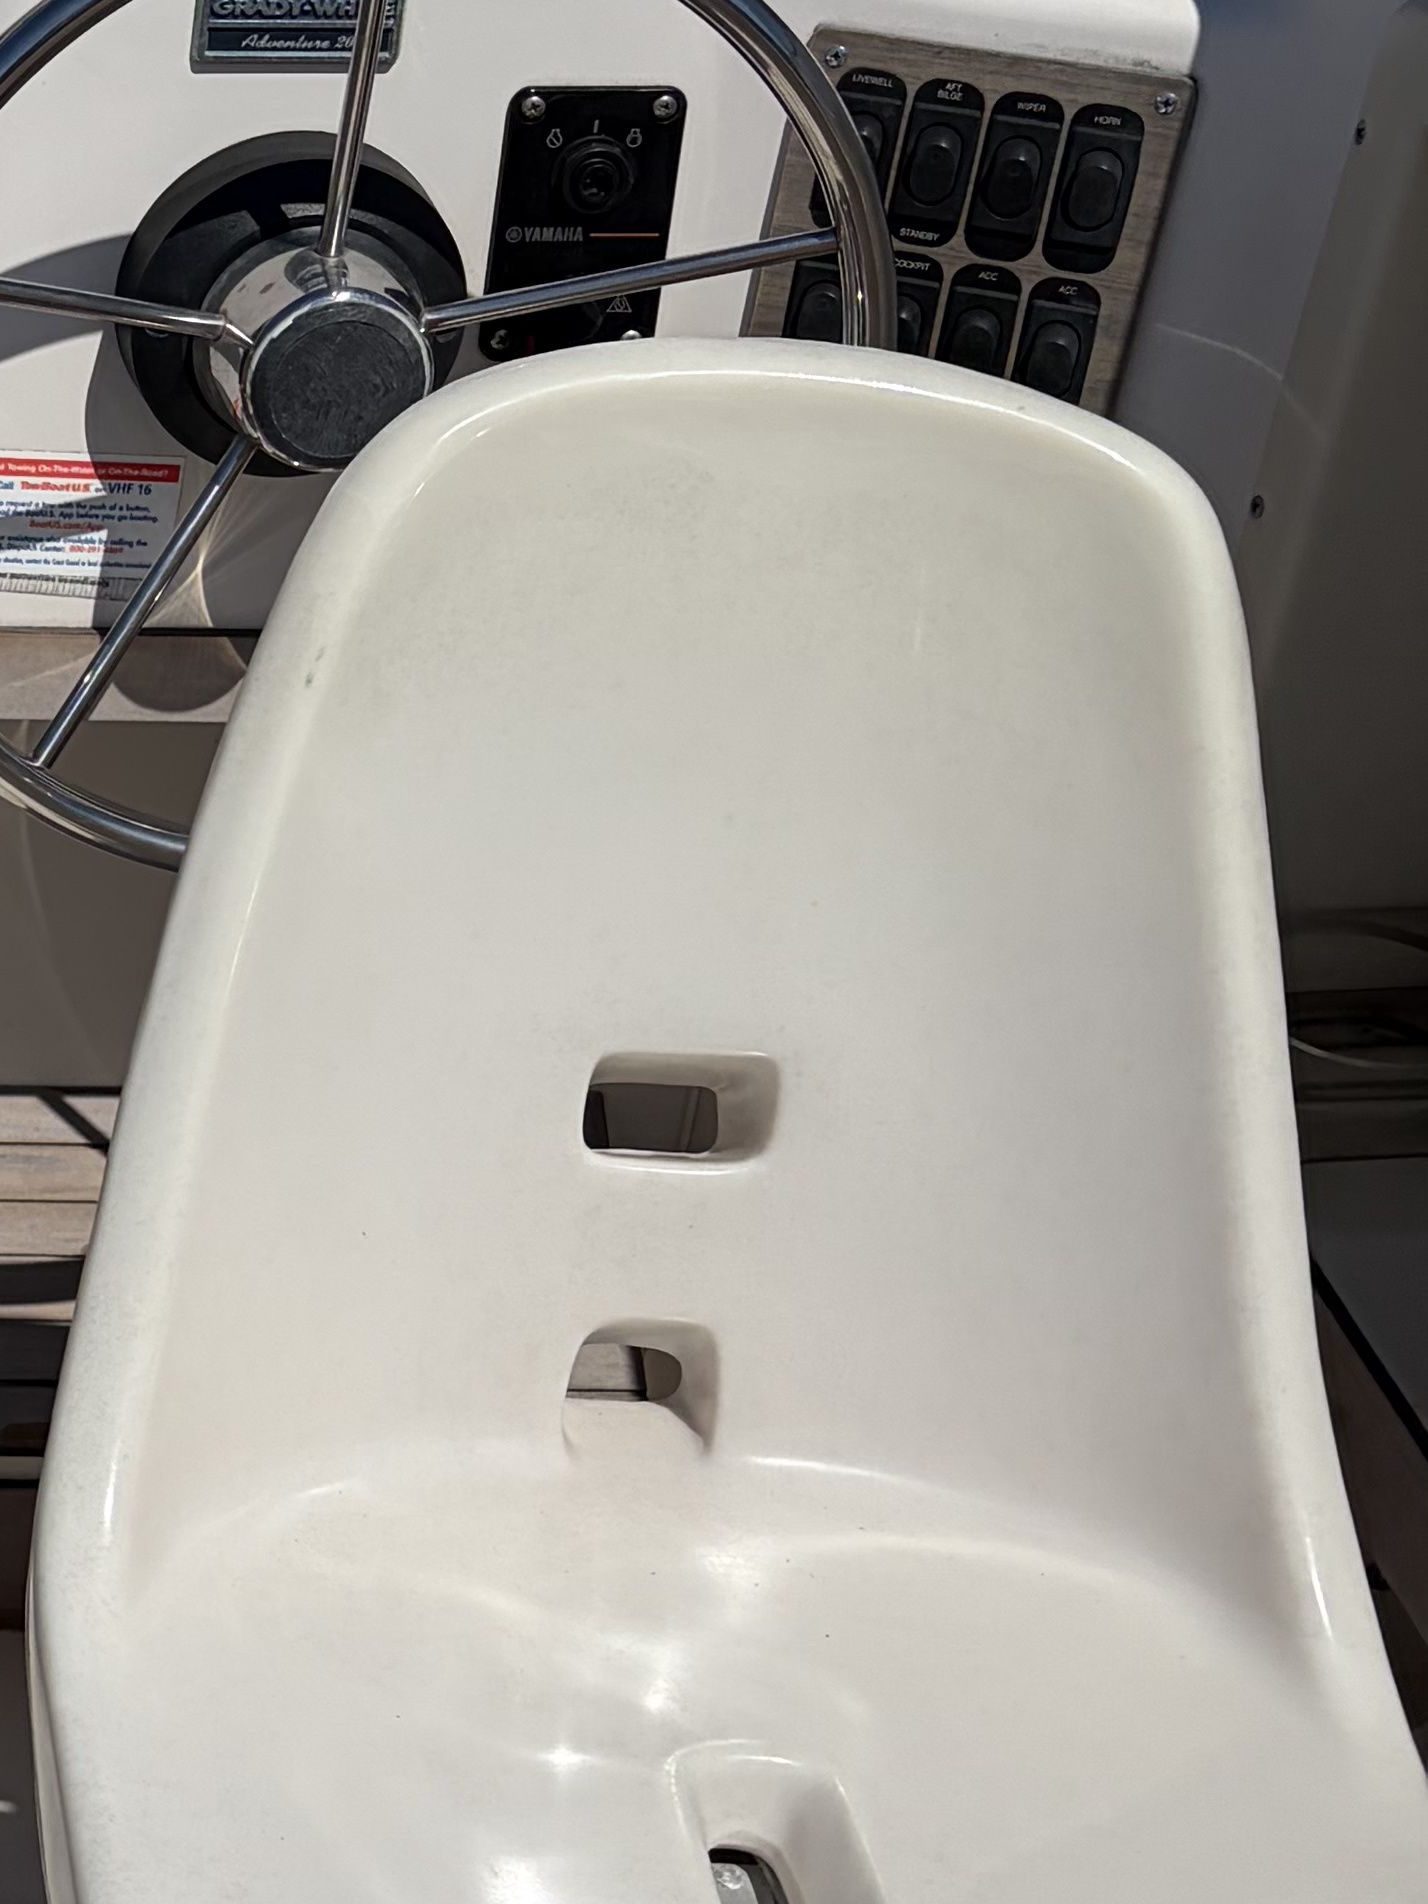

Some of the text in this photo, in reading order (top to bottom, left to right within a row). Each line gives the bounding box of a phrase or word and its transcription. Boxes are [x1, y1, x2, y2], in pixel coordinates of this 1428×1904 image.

[242, 34, 330, 48] Adventure
[852, 74, 893, 88] LIVEWELL
[946, 82, 962, 91] AFT
[937, 89, 963, 101] BILGE
[1017, 102, 1046, 113] WIPER
[1094, 115, 1121, 127] HORN
[524, 227, 583, 242] YAMAHA
[899, 227, 941, 242] STANDBY
[978, 271, 999, 281] ACC
[1058, 285, 1078, 296] ACC
[8, 463, 36, 473] Towing
[108, 483, 134, 494] VHF
[138, 484, 152, 495] 16
[59, 510, 74, 519] App
